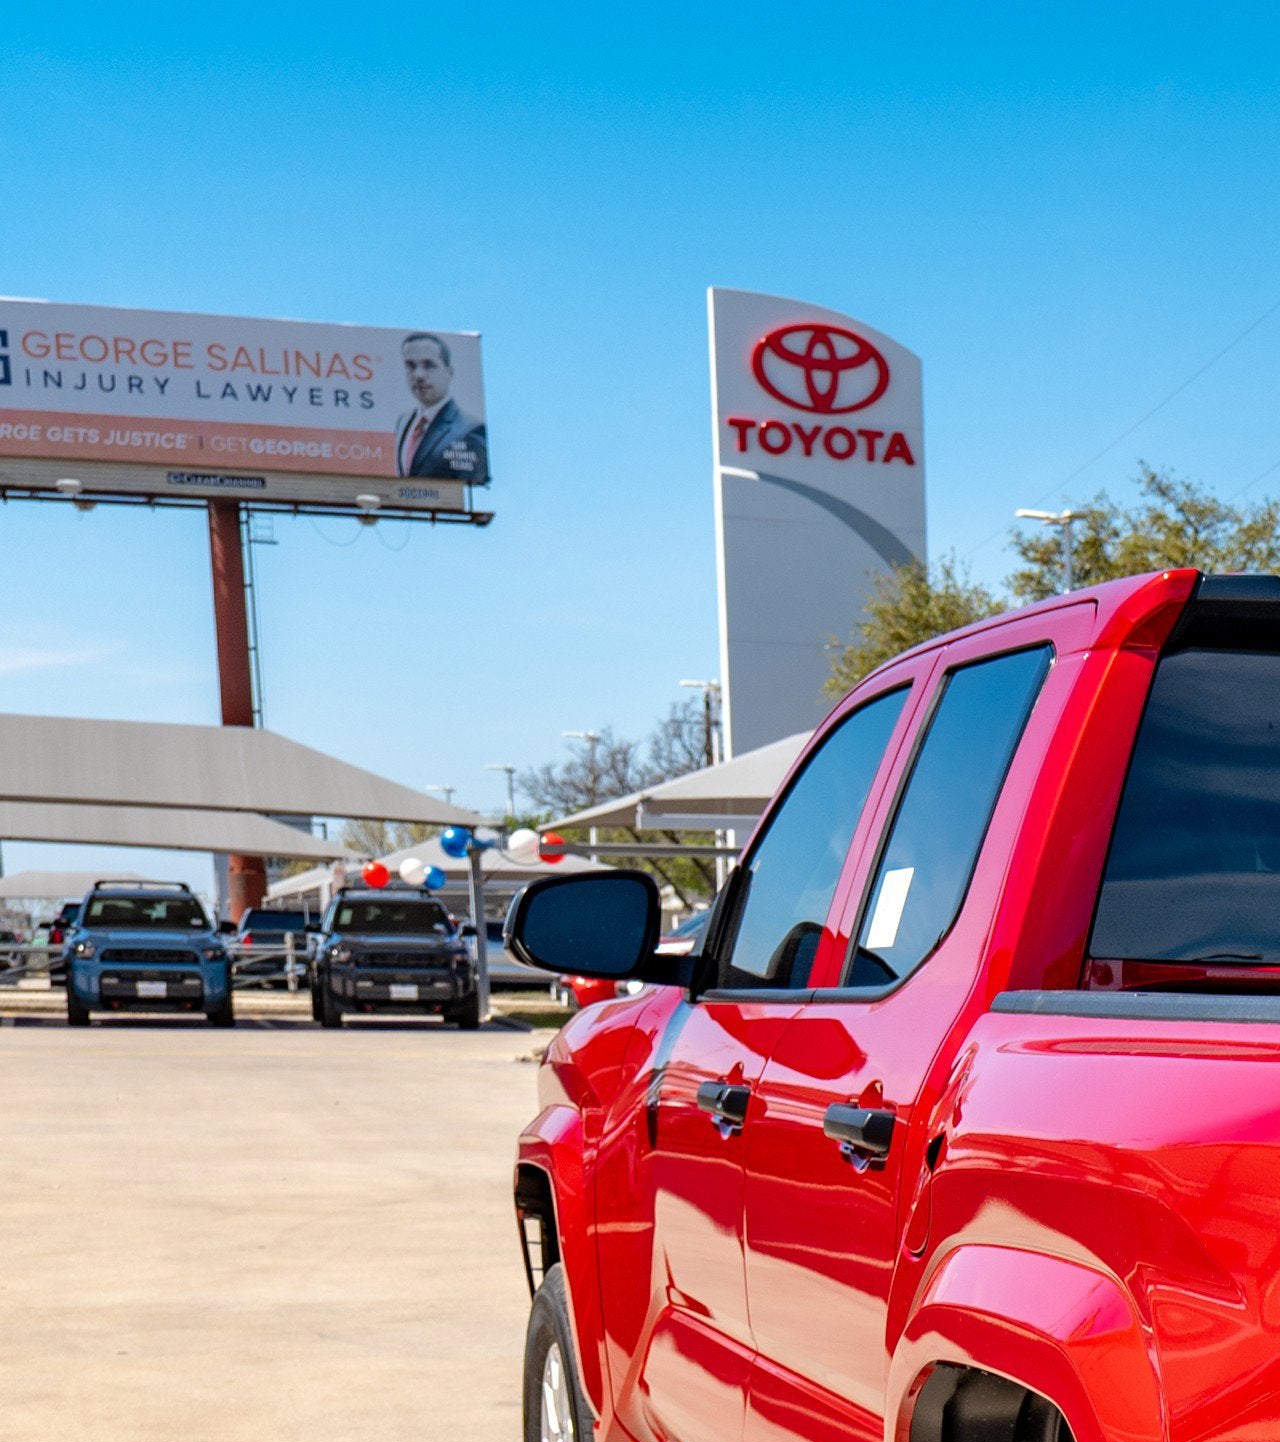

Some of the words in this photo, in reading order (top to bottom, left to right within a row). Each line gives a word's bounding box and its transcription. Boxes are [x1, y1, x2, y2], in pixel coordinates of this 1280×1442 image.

[22, 330, 194, 369] GEORGE
[207, 343, 373, 381] SALINAS
[25, 368, 170, 395] INJURY
[195, 379, 375, 409] LAWYERS
[46, 426, 100, 443] GETS
[103, 429, 187, 449] JUSTICE
[727, 418, 915, 466] TOYOTA
